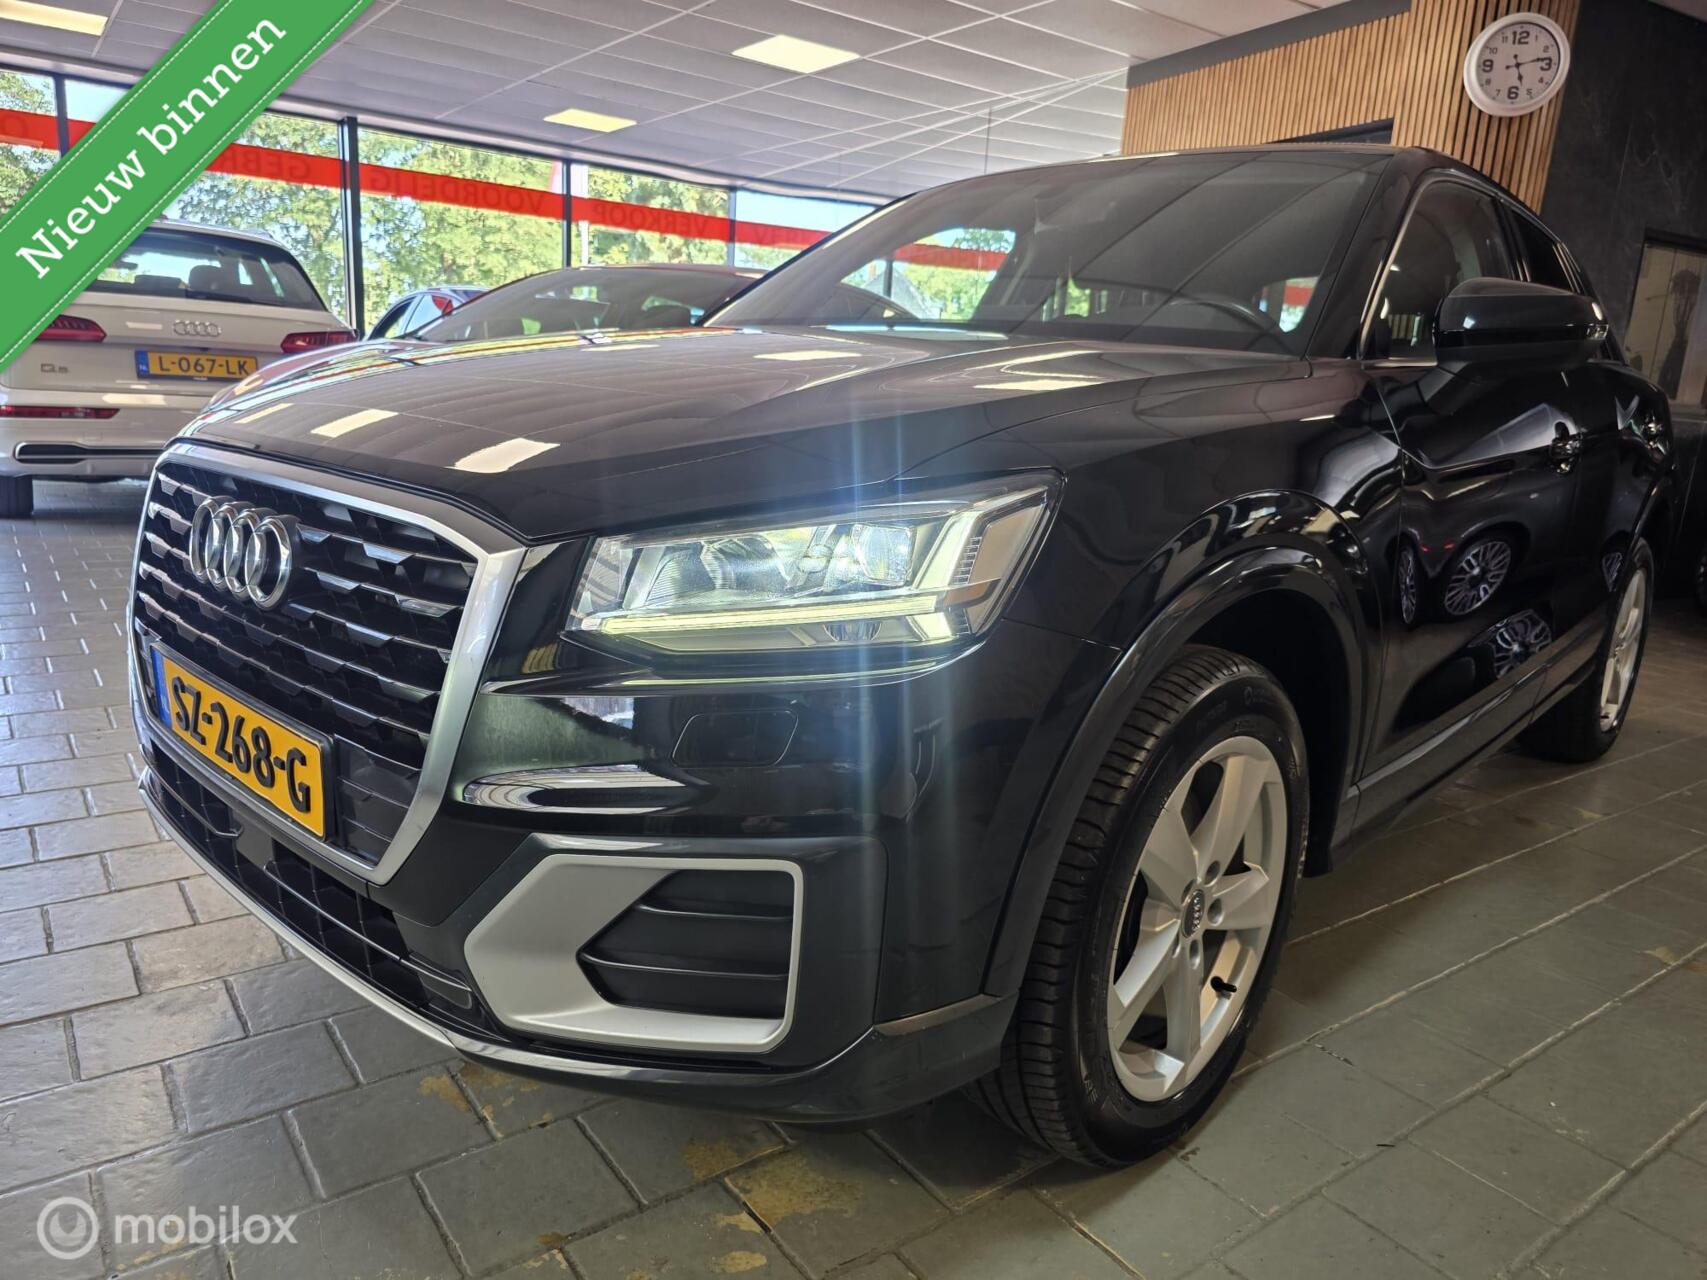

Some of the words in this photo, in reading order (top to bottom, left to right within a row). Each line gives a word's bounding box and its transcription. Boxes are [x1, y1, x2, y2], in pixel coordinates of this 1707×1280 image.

[1512, 30, 1530, 45] 12
[1482, 59, 1494, 72] 9
[1540, 57, 1552, 71] 3
[1507, 86, 1519, 100] 6
[158, 356, 250, 375] L-067-LK
[172, 676, 311, 813] SZ-268-G
